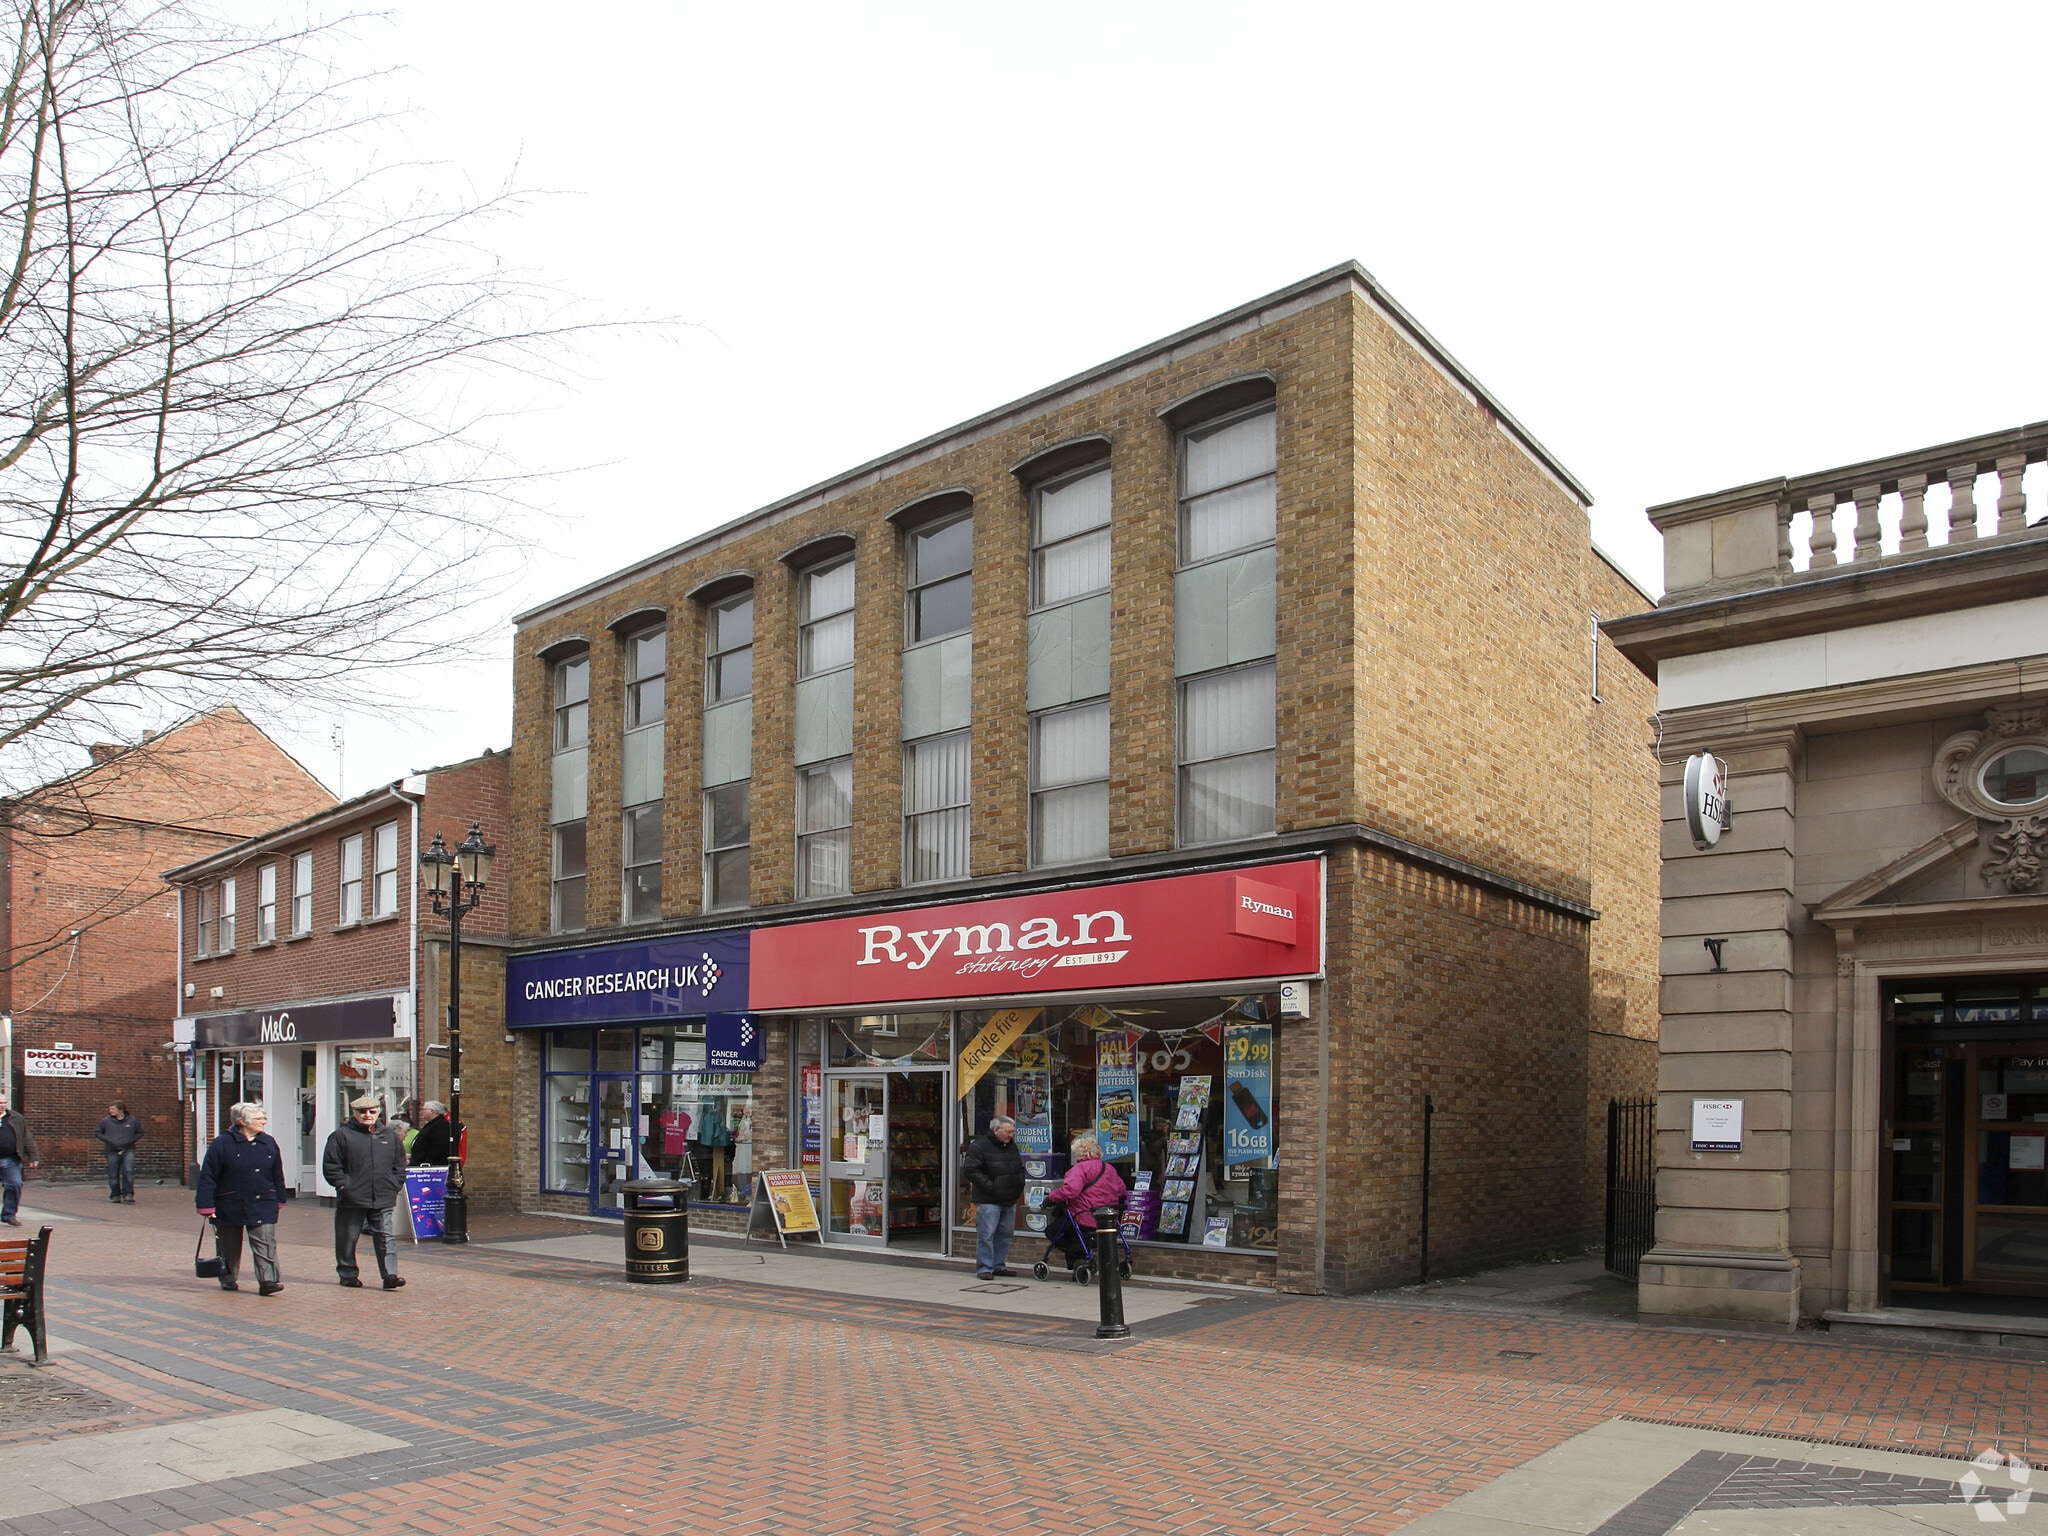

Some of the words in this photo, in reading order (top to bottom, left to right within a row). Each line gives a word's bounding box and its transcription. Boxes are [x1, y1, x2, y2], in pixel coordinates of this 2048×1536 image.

[1241, 896, 1294, 920] Ryman
[856, 910, 1132, 970] Ryman
[1065, 956, 1086, 965] EST.
[1092, 952, 1116, 963] 1893
[955, 954, 1059, 978] stationery
[525, 978, 582, 1000] CANCER
[586, 968, 668, 995] RESEARCH
[674, 965, 699, 988] UK
[260, 1012, 297, 1043] M&Co.
[963, 1032, 1000, 1070] kindle
[995, 1011, 1019, 1036] fire
[711, 1050, 738, 1058] CANCER
[1228, 1036, 1268, 1062] £9.99
[27, 1051, 96, 1061] DISCOUNT
[1024, 1054, 1034, 1062] for
[1031, 1048, 1046, 1068] 2
[1100, 1053, 1132, 1066] PRICE
[2011, 1058, 2034, 1067] Pay
[35, 1061, 88, 1070] CYCLES
[1227, 1069, 1267, 1078] SanDisk
[1098, 1077, 1136, 1086] BATTERIES
[1016, 1128, 1047, 1136] STUDENT
[1228, 1128, 1267, 1148] 16GB
[1106, 1142, 1129, 1155] £3.49
